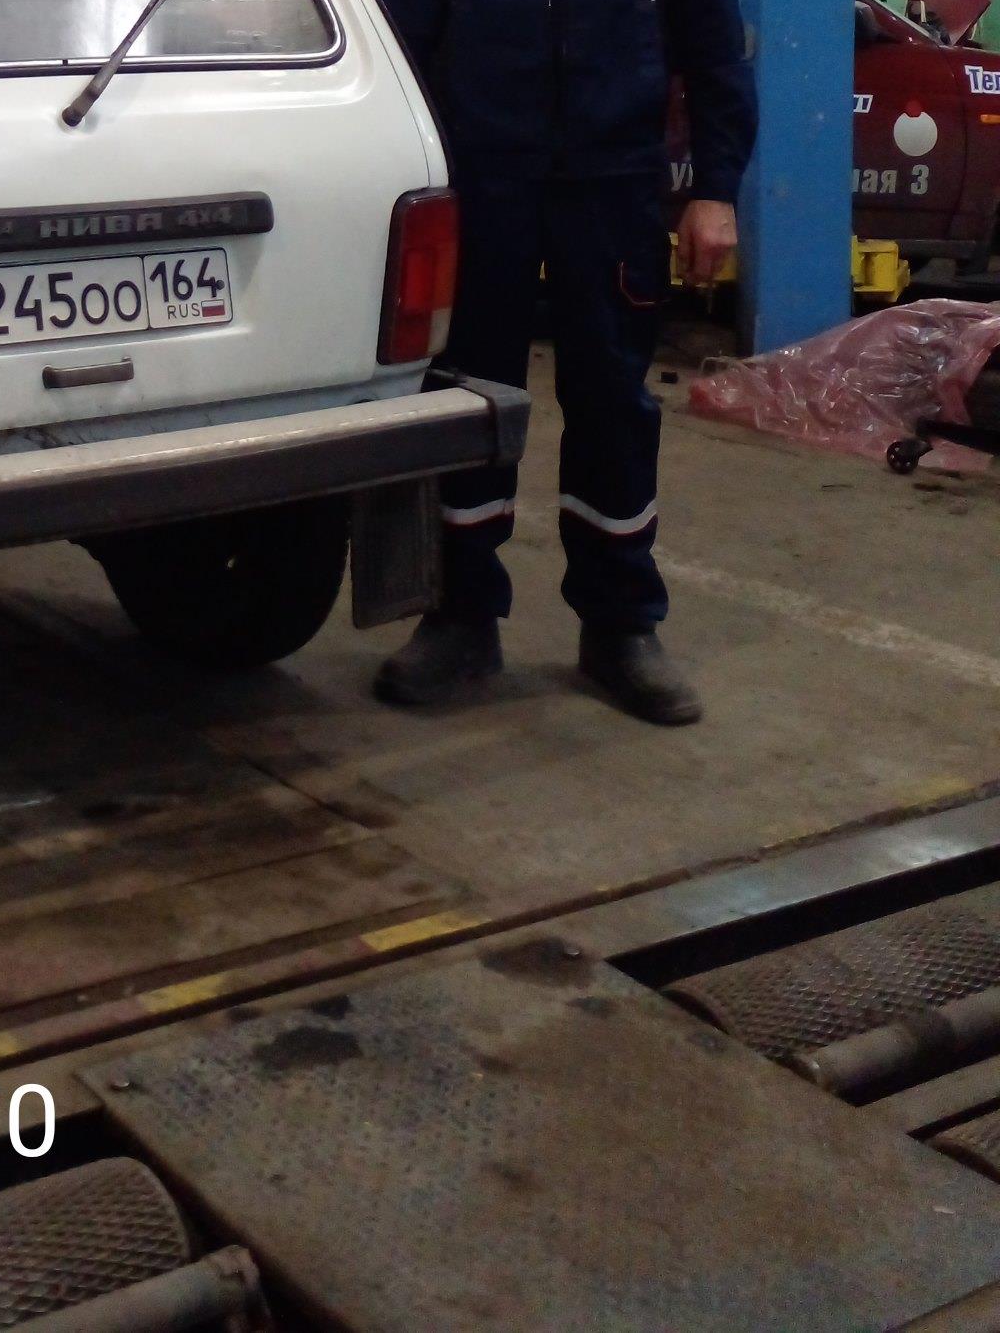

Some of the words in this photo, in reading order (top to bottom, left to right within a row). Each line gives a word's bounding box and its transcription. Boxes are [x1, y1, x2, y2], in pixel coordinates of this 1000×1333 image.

[910, 164, 930, 195] 3
[39, 212, 164, 238] НИВА
[149, 257, 218, 302] 164
[168, 302, 201, 319] RUS
